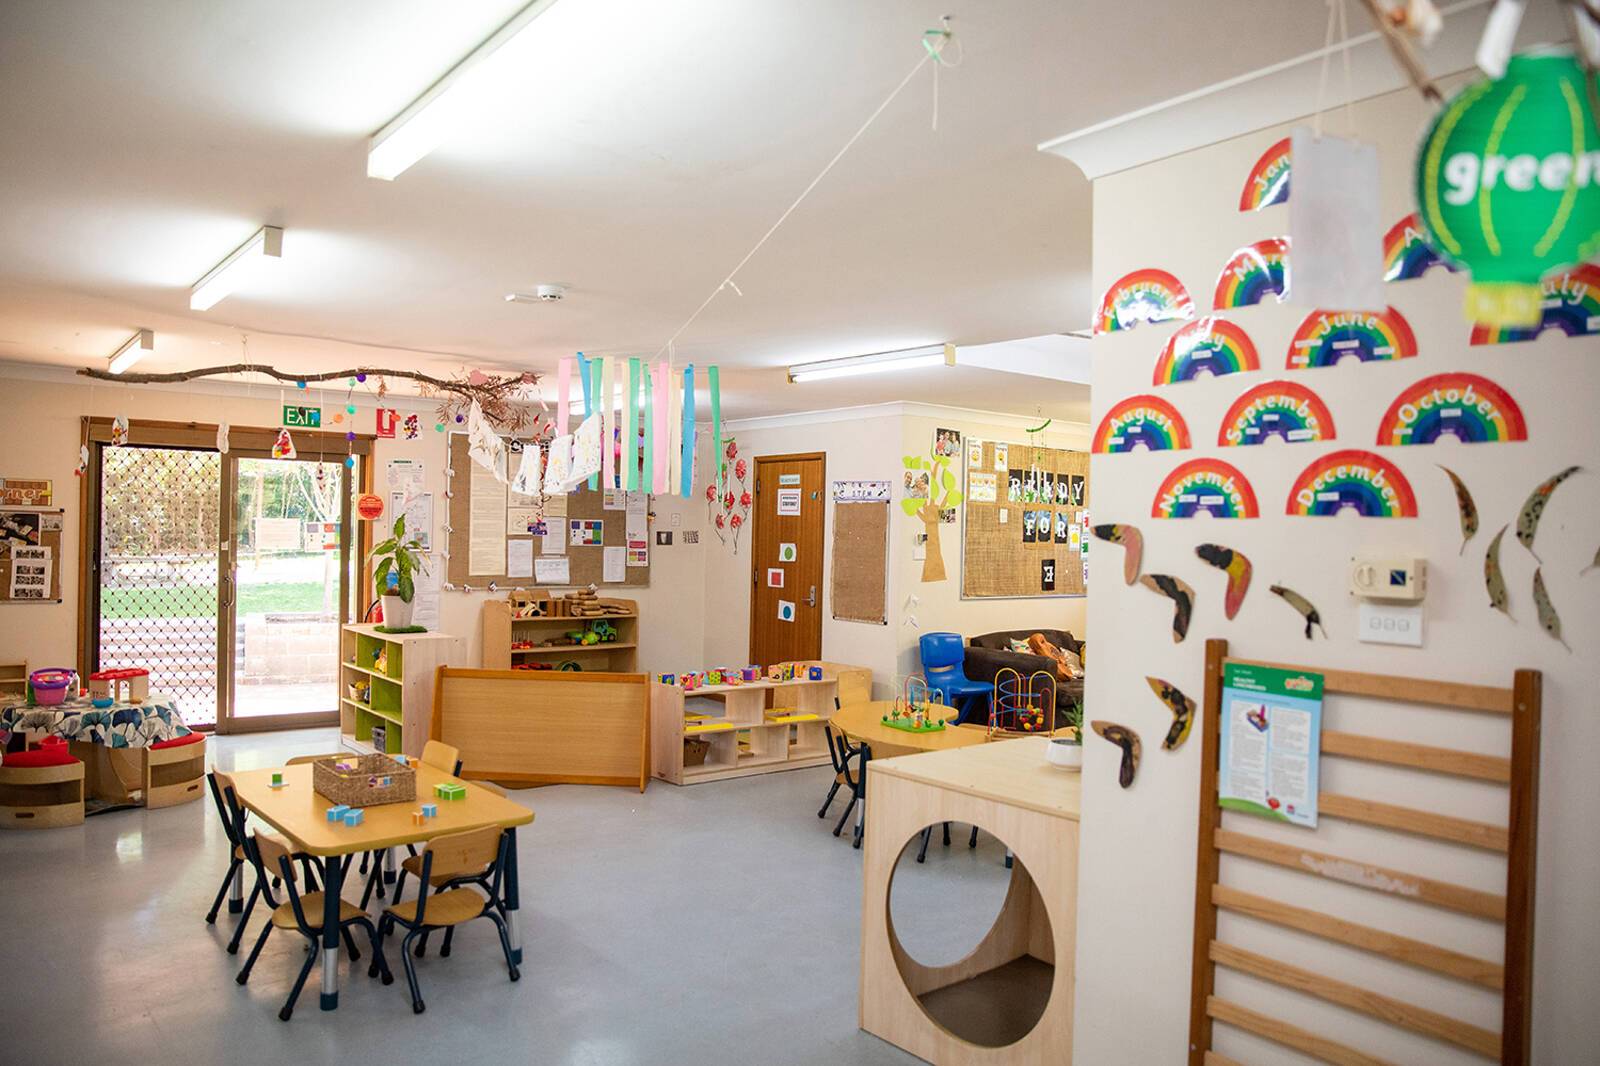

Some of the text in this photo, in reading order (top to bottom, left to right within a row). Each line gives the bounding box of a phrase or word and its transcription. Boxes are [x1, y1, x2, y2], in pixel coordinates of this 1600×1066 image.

[1444, 151, 1600, 206] green
[1541, 272, 1589, 306] uly
[1318, 312, 1377, 335] June
[286, 408, 318, 425] EXIT
[1109, 407, 1174, 433] August
[1226, 395, 1322, 442] September
[1398, 384, 1501, 424] October
[1159, 471, 1245, 512] November
[1297, 464, 1399, 508] December
[1024, 517, 1067, 539] FOR
